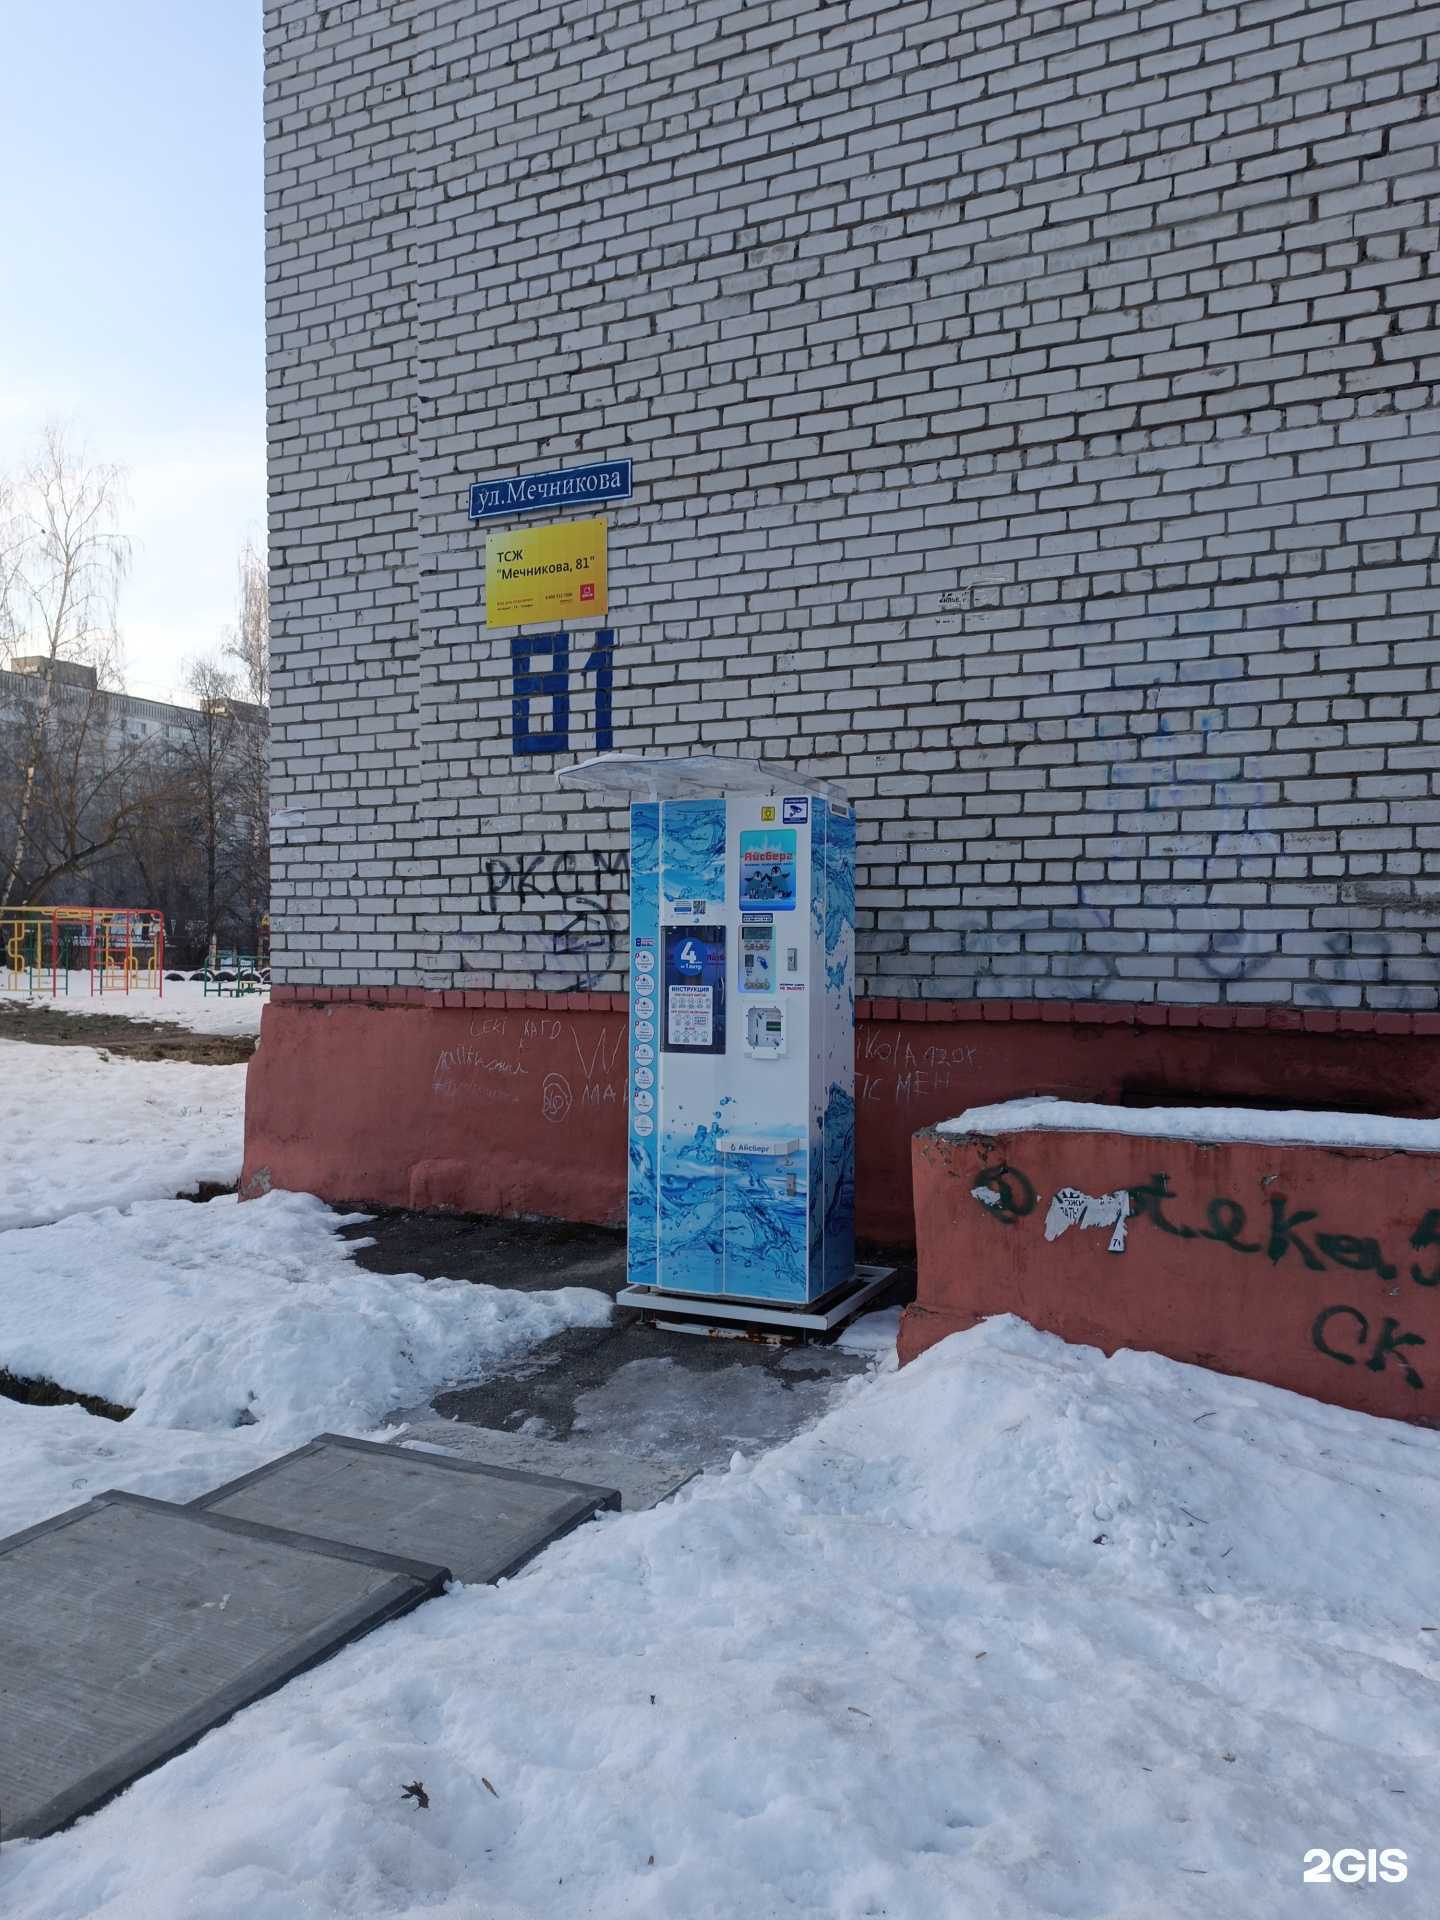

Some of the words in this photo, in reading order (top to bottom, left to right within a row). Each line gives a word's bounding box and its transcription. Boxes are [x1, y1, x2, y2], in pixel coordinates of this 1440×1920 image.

[478, 471, 621, 513] ул.Мечникова
[496, 549, 524, 563] ТСЖ
[512, 630, 614, 757] 81
[680, 941, 697, 964] 4
